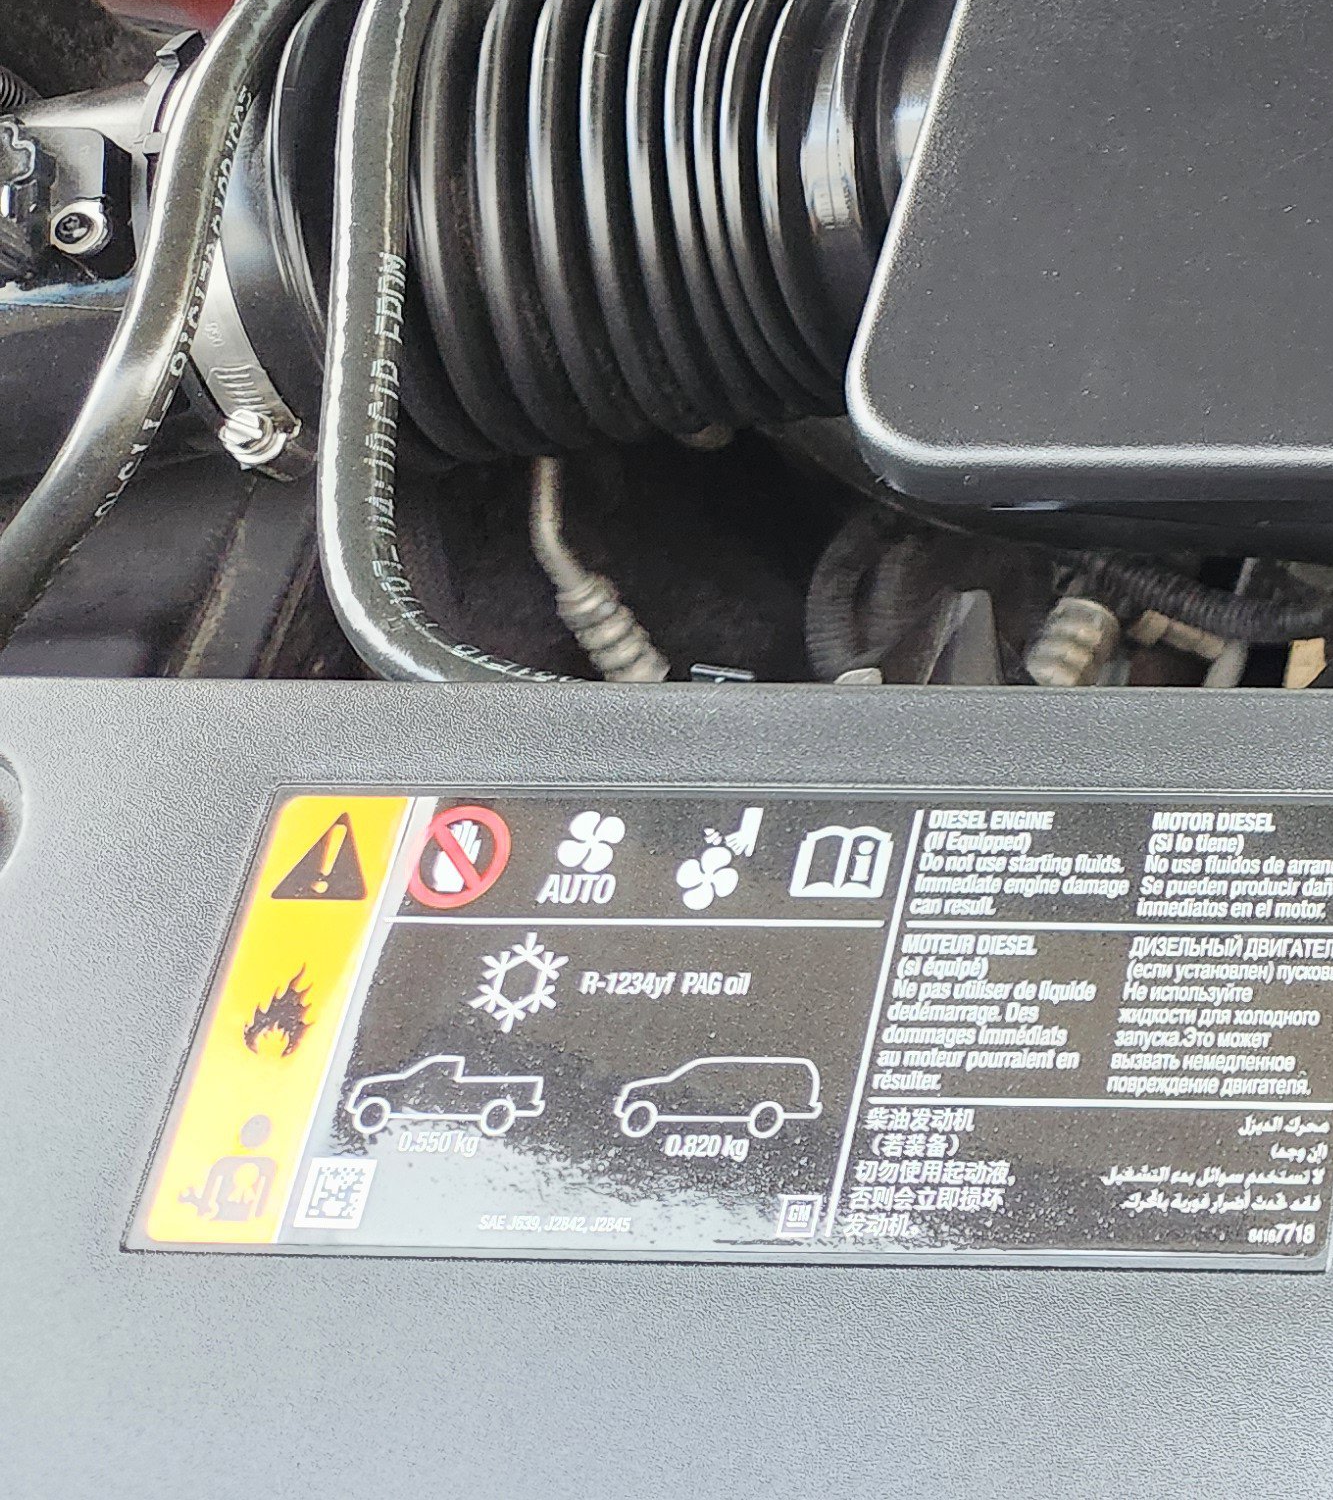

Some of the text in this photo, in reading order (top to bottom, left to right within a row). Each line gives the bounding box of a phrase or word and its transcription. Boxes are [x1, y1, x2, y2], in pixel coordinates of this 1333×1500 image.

[928, 810, 1055, 830] DIESEL ENGINE
[1152, 812, 1276, 832] MOTOR DIESEL
[947, 832, 1032, 854] Equipped)
[1175, 834, 1193, 852] lo
[1196, 834, 1244, 856] tiene)
[919, 853, 1125, 876] Do not use starting fluids.
[1144, 855, 1169, 874] No
[1172, 858, 1202, 874] use
[1205, 855, 1261, 874] fluidos
[1263, 856, 1285, 875] de
[536, 874, 616, 904] AUTO
[914, 874, 1130, 899] Immediate engine damage
[1140, 876, 1164, 895] Se
[1166, 877, 1228, 898] pueden
[1230, 878, 1301, 899] producir
[909, 896, 997, 916] can result.
[1136, 898, 1327, 919] inmediatos en el motor.
[902, 934, 1038, 956] MOTEUR DIESEL
[1129, 934, 1242, 960] ДИЗЕЛЬНЫЙ
[922, 956, 989, 980] équipé)
[1175, 961, 1275, 984] установлен)
[579, 971, 752, 999] R-1234yf PAG oil
[892, 979, 1097, 1004] Ne pas utiliser de liquide
[1122, 982, 1253, 1006] Не используйте
[1005, 1003, 1039, 1023] Des
[1118, 1007, 1321, 1028] жидкости для холодного
[882, 1024, 1068, 1048] dommages immédiats
[1217, 1031, 1273, 1048] может
[877, 1047, 1080, 1072] au moteur pourraient en
[1111, 1053, 1296, 1074] вызвать немедленное
[872, 1070, 942, 1090] résulter.
[1106, 1076, 1311, 1097] повреждение двигателя.
[864, 1107, 976, 1132] 柴油发动机
[398, 1131, 480, 1158] 0.550 kg
[665, 1133, 750, 1162] 0.820 kg
[849, 1186, 1005, 1212] 否则会立即损坏
[478, 1214, 507, 1231] SAE
[590, 1216, 632, 1233] J2845
[787, 1204, 812, 1223] GM
